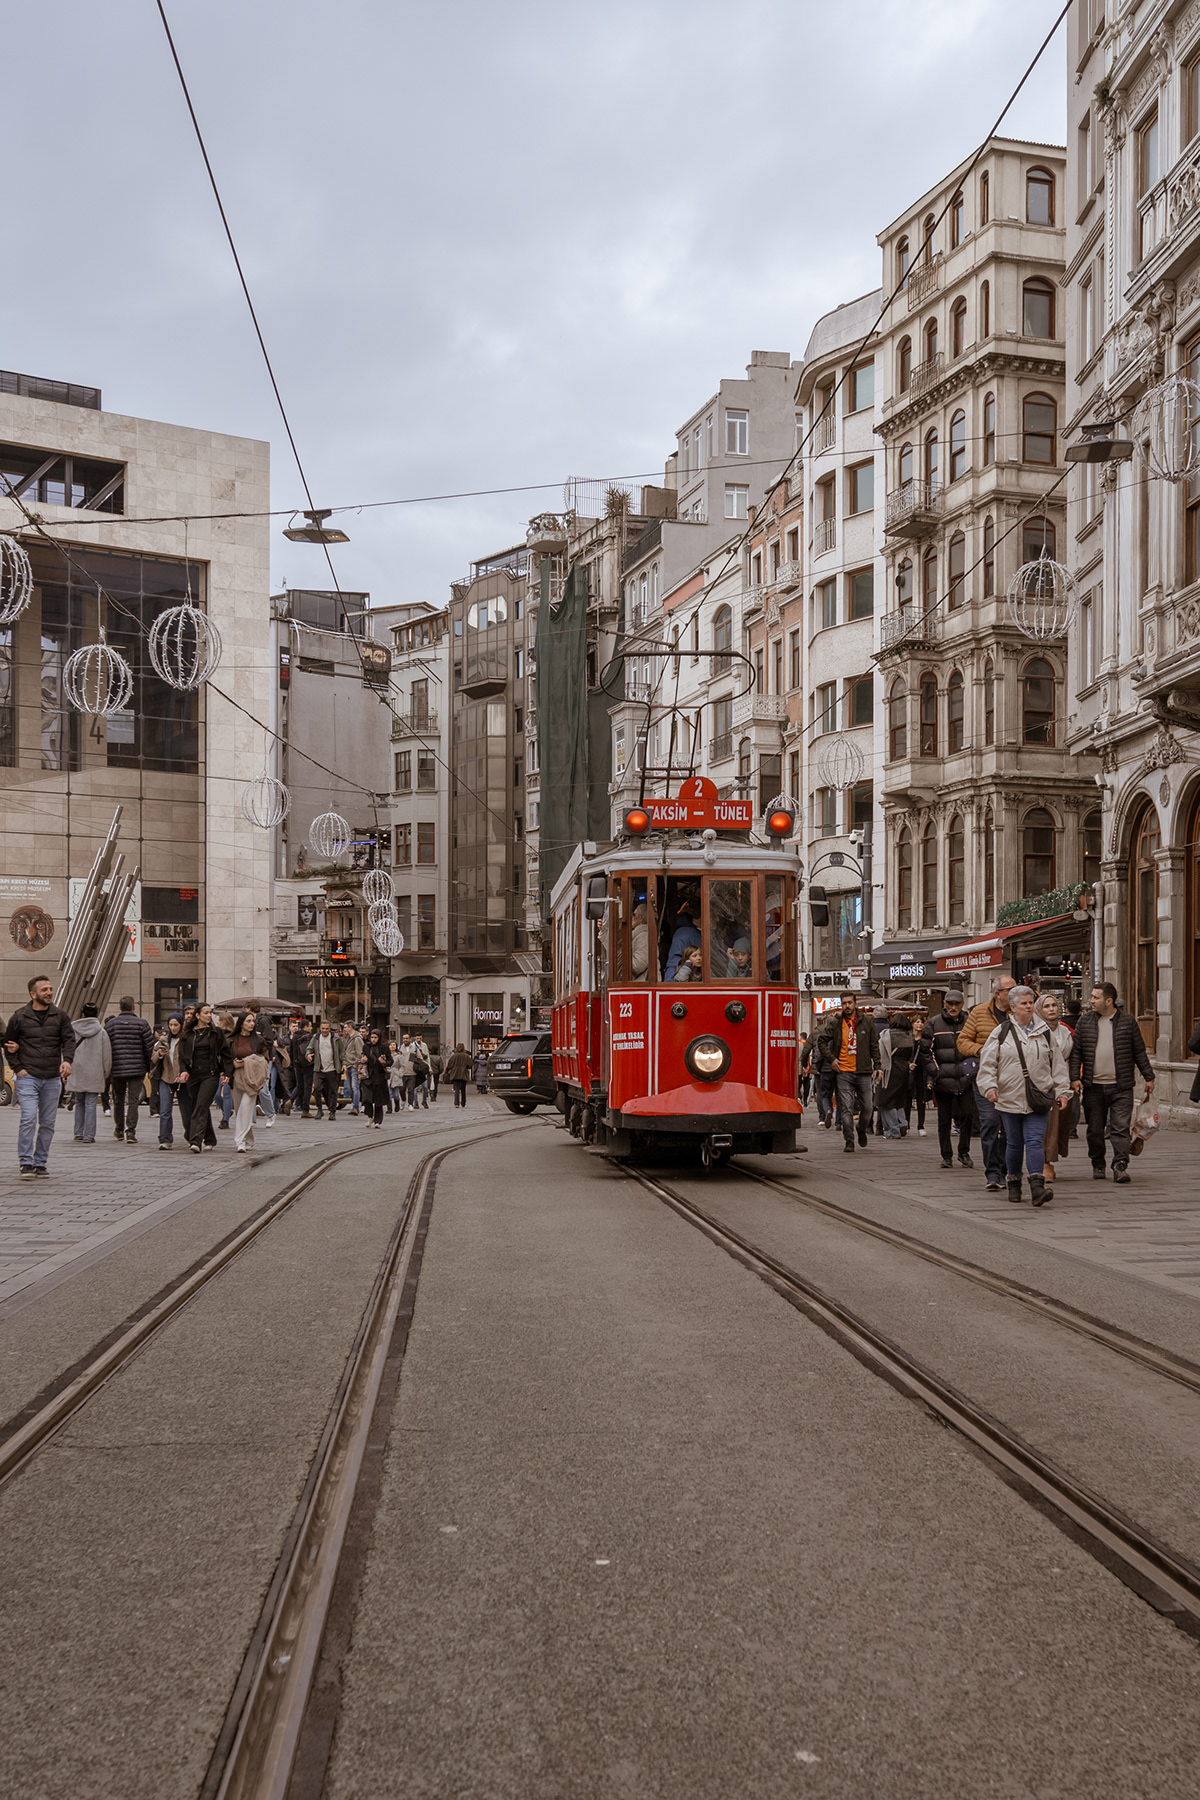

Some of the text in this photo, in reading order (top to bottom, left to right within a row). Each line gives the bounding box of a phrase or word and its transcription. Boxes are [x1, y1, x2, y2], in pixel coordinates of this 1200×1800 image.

[90, 713, 104, 744] 4
[695, 779, 703, 797] 2
[714, 802, 749, 821] TÜNEL
[325, 969, 339, 977] CAFE
[890, 963, 925, 980] patsosis
[474, 1006, 503, 1020] flormar
[620, 1003, 632, 1018] 223
[628, 1031, 644, 1040] YASAK
